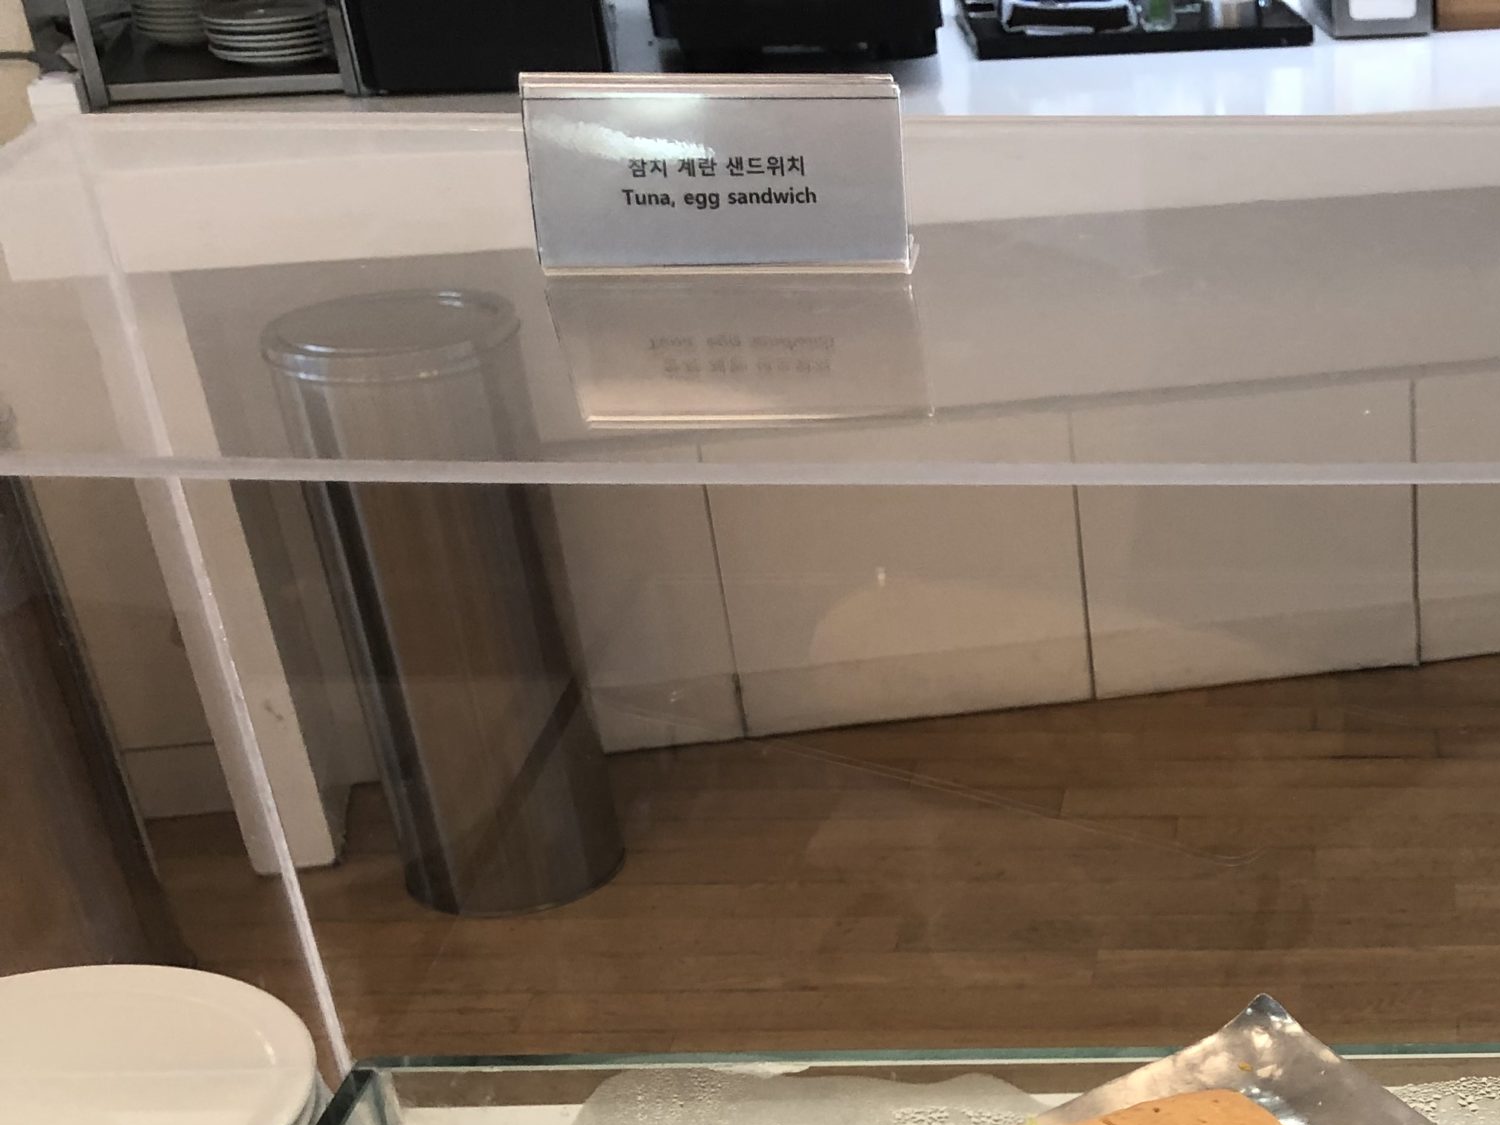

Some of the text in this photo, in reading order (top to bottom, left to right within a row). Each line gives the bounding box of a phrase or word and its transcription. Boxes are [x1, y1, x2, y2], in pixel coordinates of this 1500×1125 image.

[677, 155, 718, 178] 계란
[725, 155, 806, 177] 샌드위치
[621, 186, 817, 210] Tuna, egg sandwich
